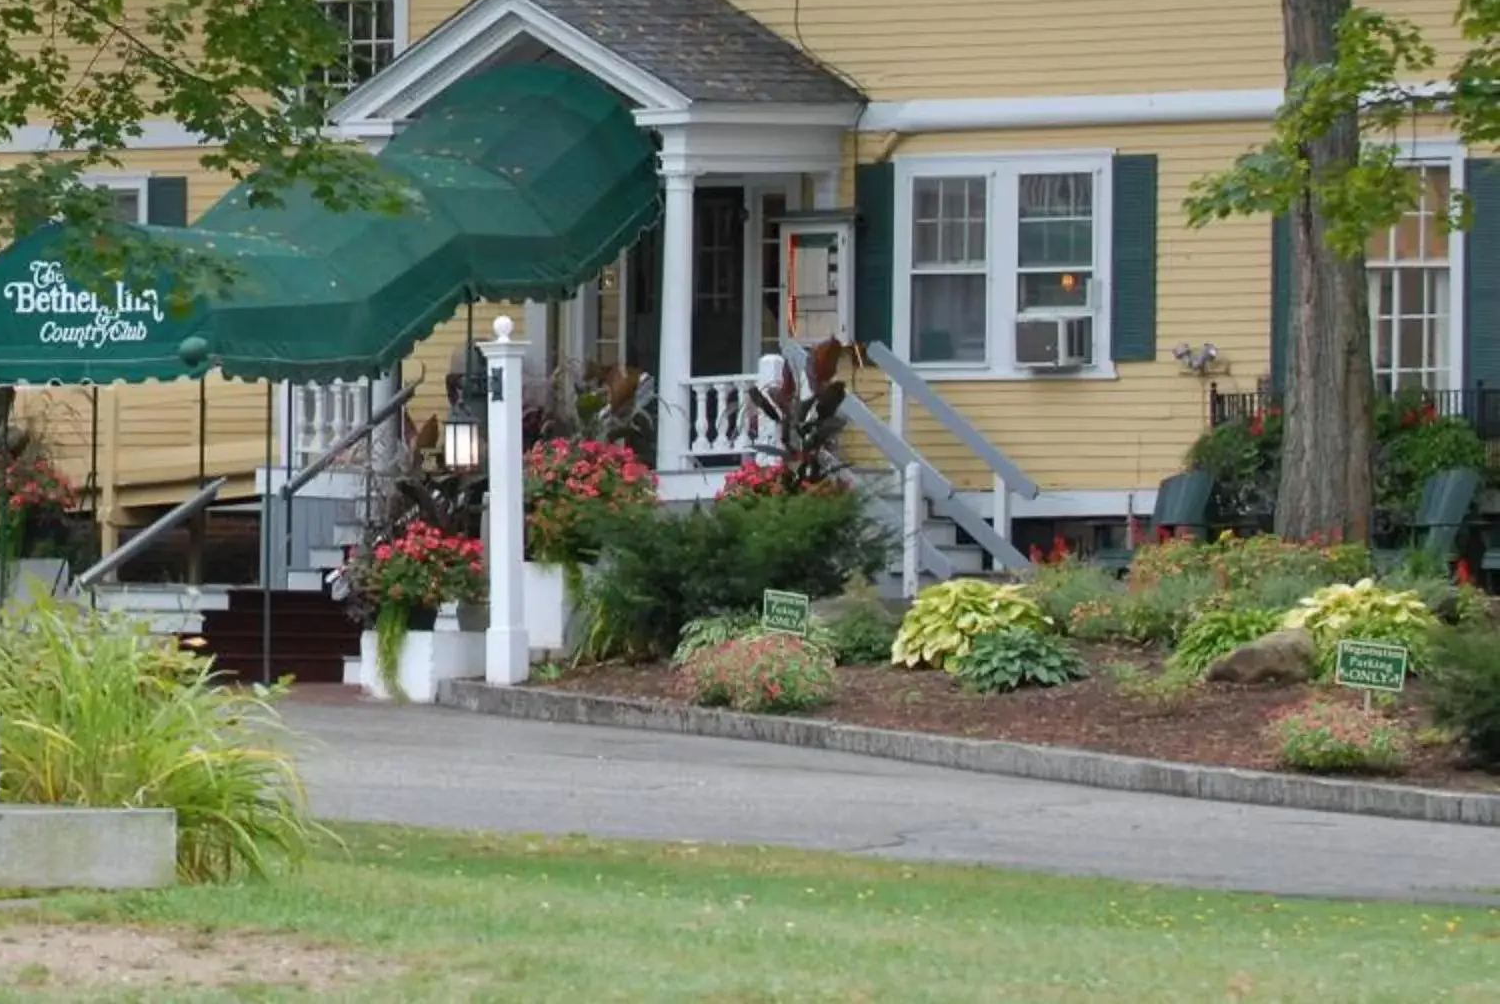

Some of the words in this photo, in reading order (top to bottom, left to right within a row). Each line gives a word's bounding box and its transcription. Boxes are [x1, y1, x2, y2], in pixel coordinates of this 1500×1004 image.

[29, 260, 65, 289] The
[95, 305, 121, 327] &
[39, 321, 111, 348] Country
[109, 320, 148, 342] Club
[1349, 656, 1394, 674] Parking
[1349, 668, 1387, 684] ONLY
